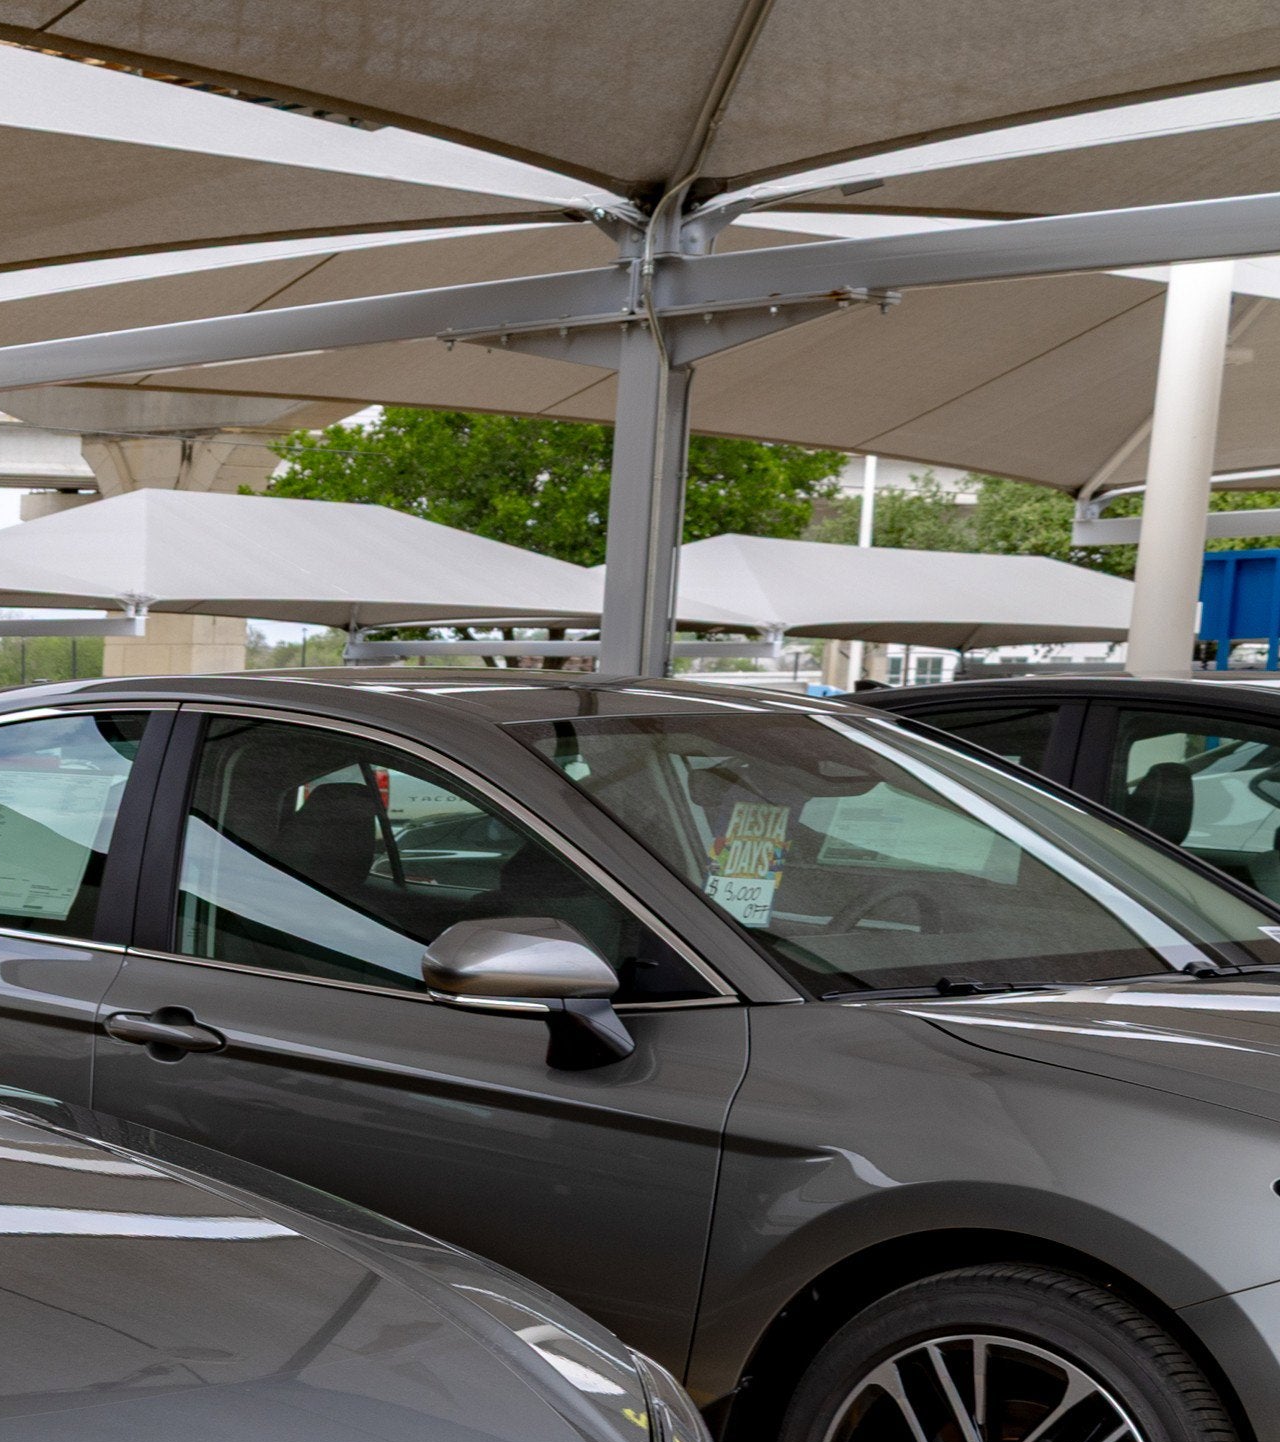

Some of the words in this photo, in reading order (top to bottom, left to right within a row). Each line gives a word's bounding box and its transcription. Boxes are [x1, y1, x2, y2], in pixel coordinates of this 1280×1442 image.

[725, 802, 790, 842] FIESTA
[725, 841, 774, 876] DAYS
[743, 903, 771, 919] OFF
